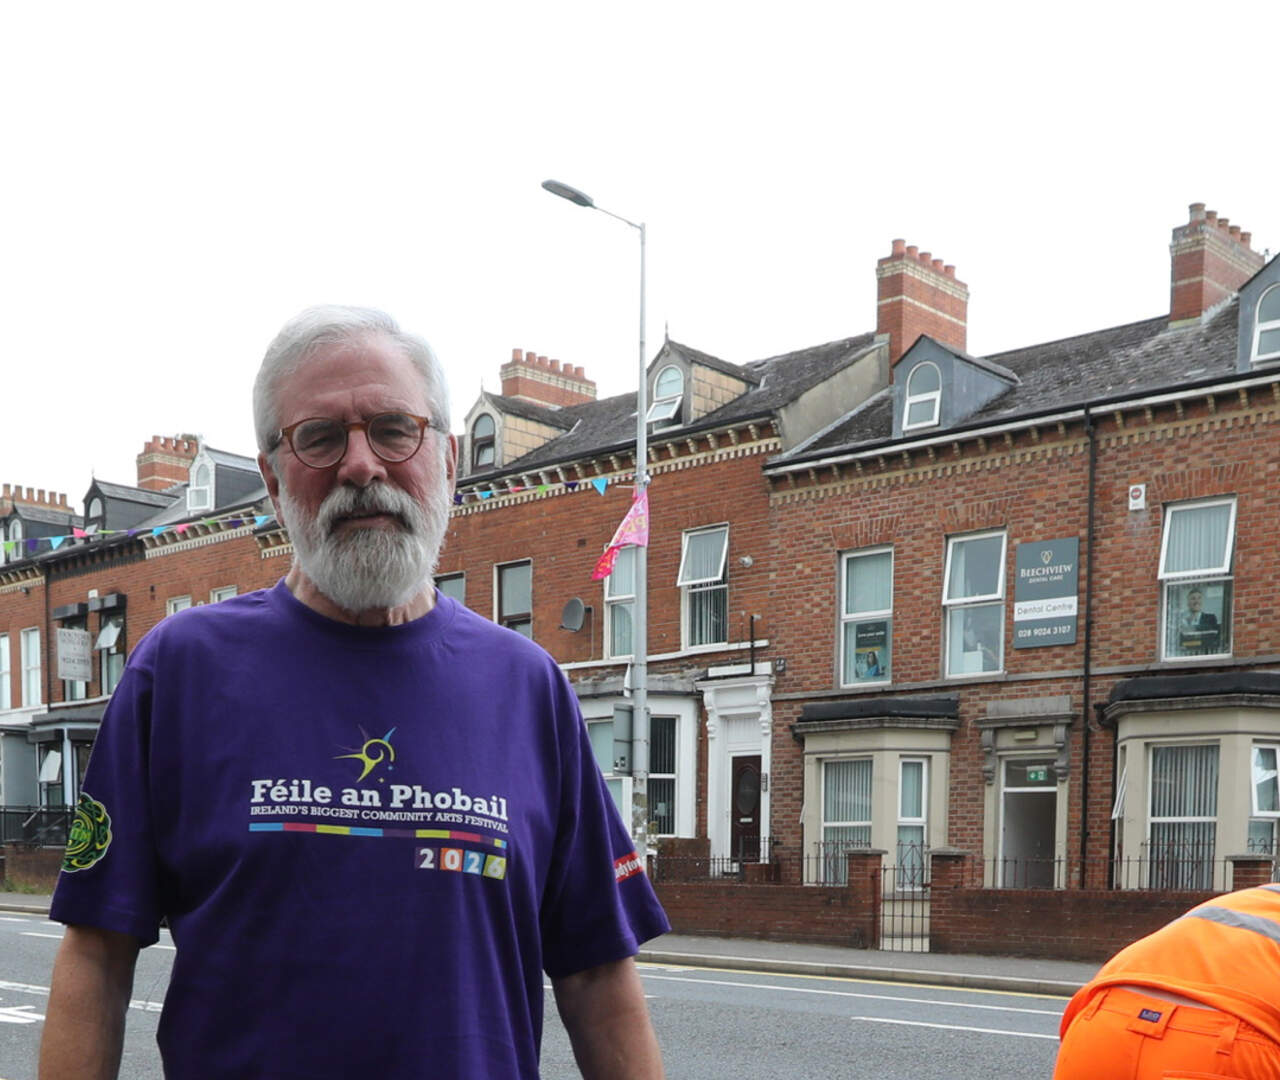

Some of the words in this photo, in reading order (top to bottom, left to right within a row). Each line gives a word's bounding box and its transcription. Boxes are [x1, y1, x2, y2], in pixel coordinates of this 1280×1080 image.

[1020, 563, 1073, 578] BEECHVIEW
[1017, 605, 1044, 615] Dental
[1045, 603, 1073, 612] Centre
[250, 778, 332, 804] Féile
[341, 787, 382, 807] an
[389, 784, 509, 821] Phobail
[250, 805, 308, 816] IRELAND'S
[310, 806, 360, 819] BIGGEST
[361, 809, 433, 821] COMMUNITY
[435, 812, 463, 824] ARTS
[464, 815, 509, 834] FESTIVAL
